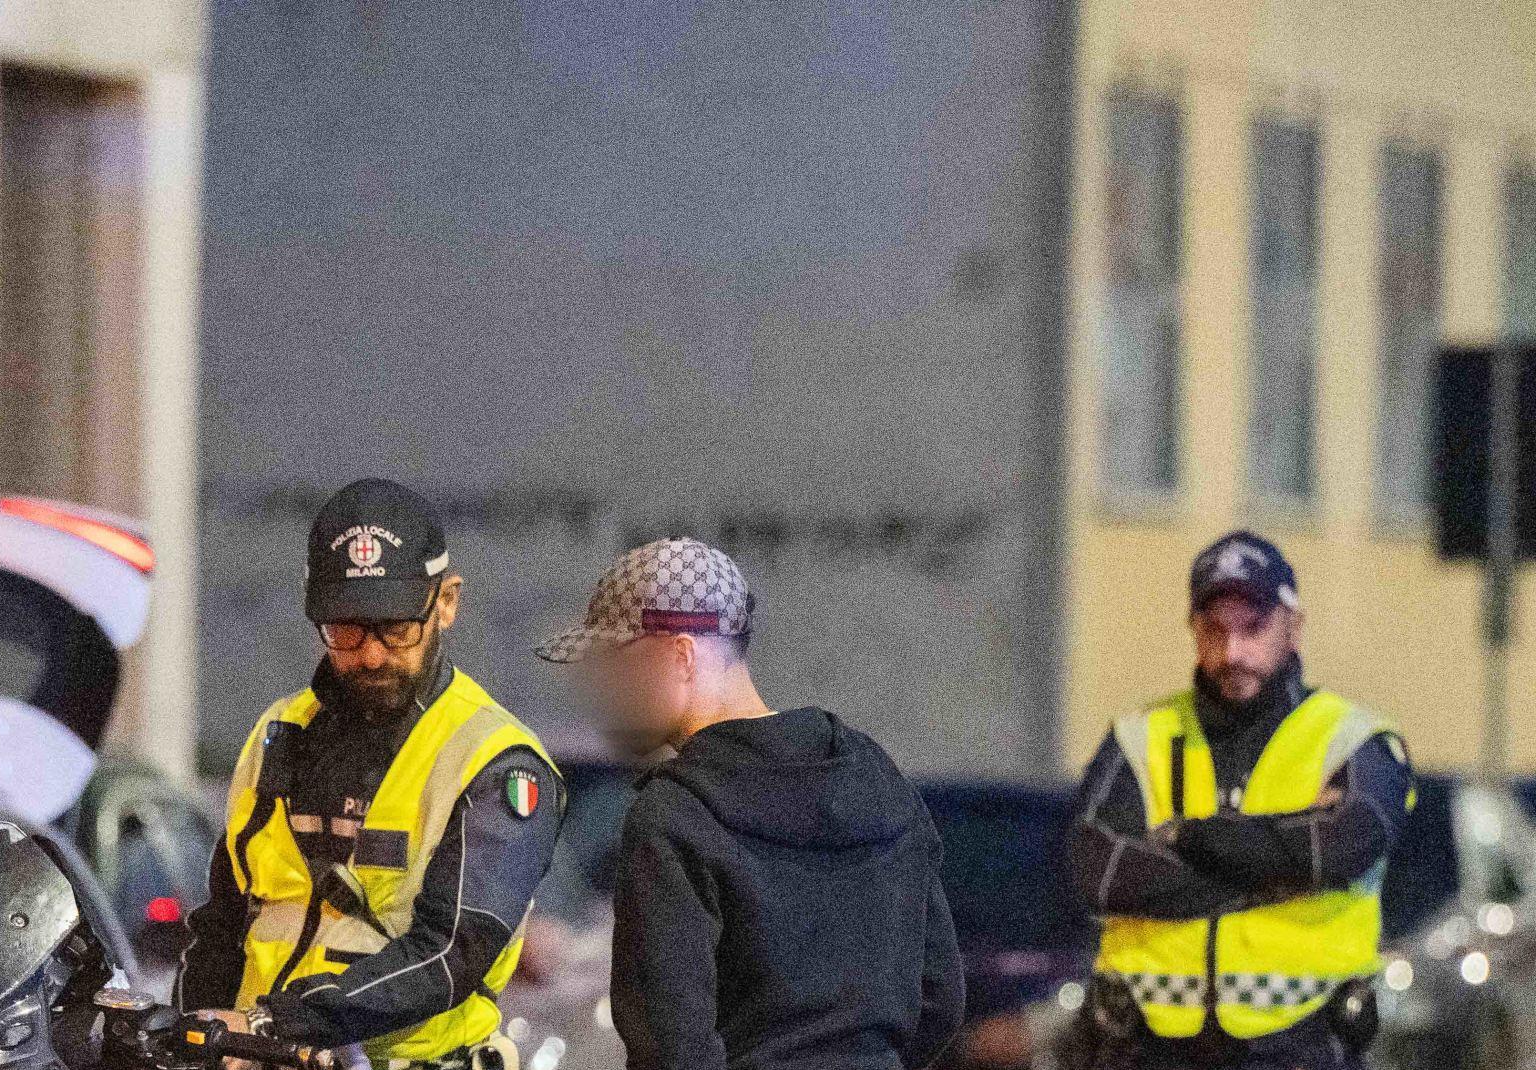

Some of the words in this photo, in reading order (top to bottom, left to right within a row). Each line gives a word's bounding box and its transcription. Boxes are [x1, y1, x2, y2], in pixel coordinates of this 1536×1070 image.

[330, 525, 363, 551] POLIZIA
[364, 524, 404, 549] LOCALE
[345, 566, 386, 578] MILANO
